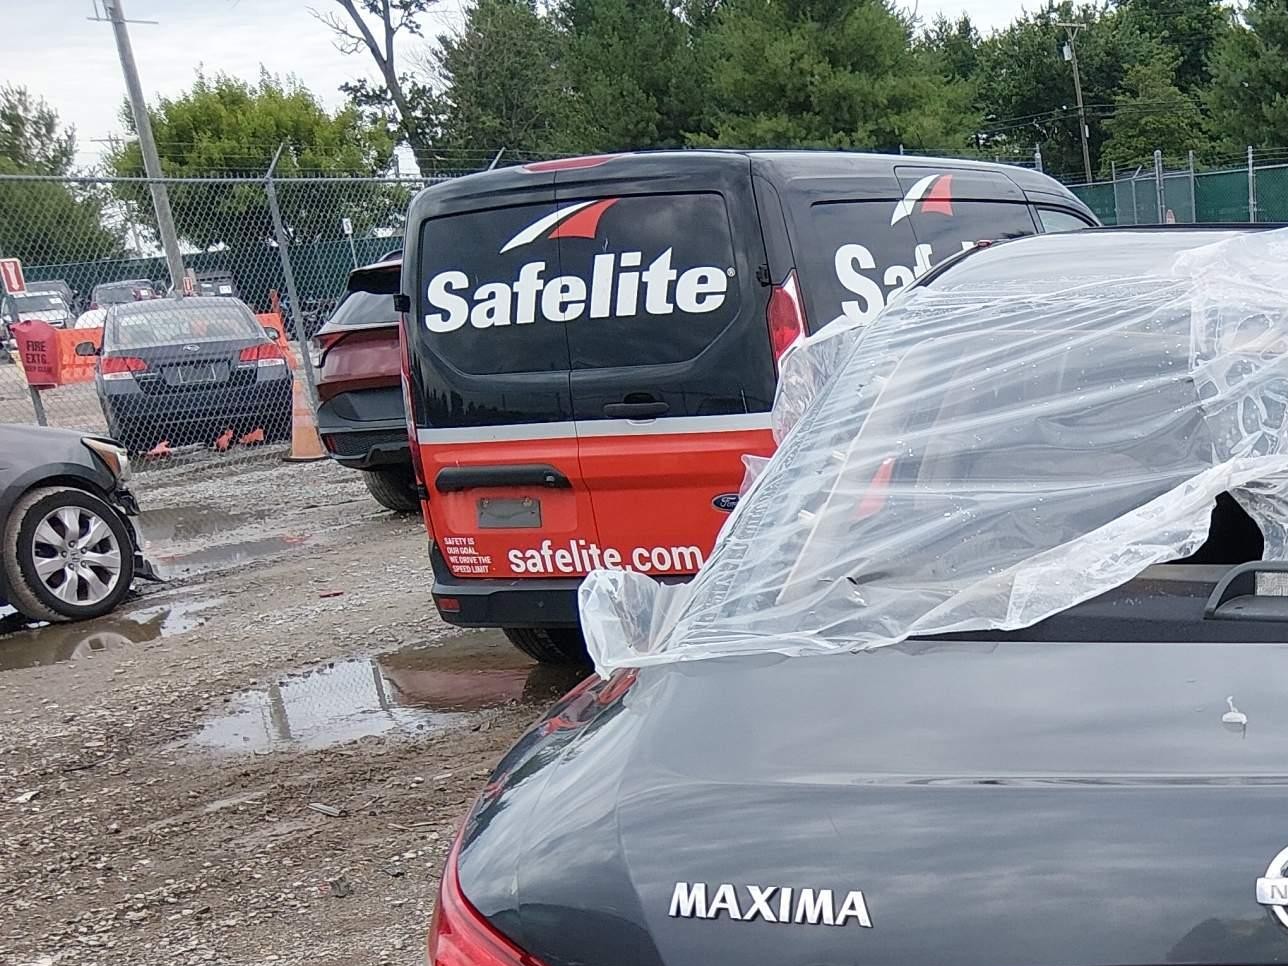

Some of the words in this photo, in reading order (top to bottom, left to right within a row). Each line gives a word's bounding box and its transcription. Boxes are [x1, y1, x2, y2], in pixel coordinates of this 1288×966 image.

[26, 340, 47, 352] FIRE
[443, 537, 466, 545] SAFETY
[467, 537, 475, 545] IS
[446, 546, 459, 554] OUR
[449, 555, 459, 564] WE
[459, 555, 478, 564] DRIVE
[478, 556, 492, 564] THE
[508, 539, 704, 574] safelite.com
[452, 565, 471, 573] SPEED
[471, 565, 489, 573] LIMIT
[668, 881, 873, 928] MAXIMA
